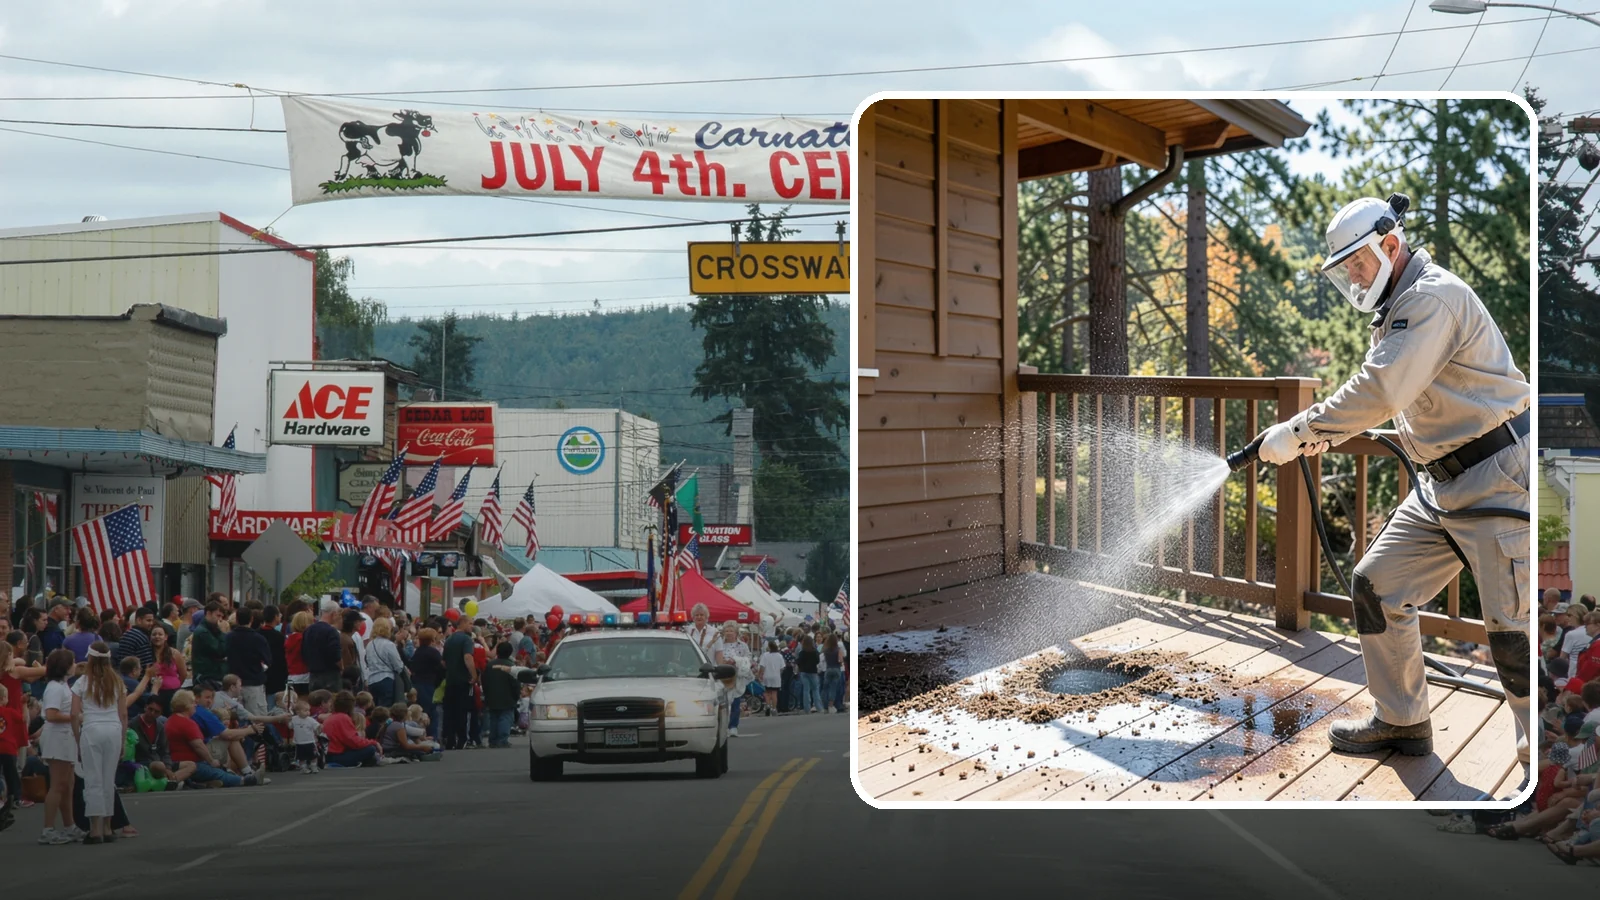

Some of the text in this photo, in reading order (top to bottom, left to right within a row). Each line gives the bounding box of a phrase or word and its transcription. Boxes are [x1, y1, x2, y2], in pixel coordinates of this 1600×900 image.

[695, 121, 850, 150] Carnat
[481, 140, 605, 193] JULY
[632, 150, 746, 198] 4th.
[697, 254, 850, 280] CROSSWA
[283, 380, 374, 420] ACE
[406, 409, 452, 422] CEDAR
[283, 421, 371, 437] Hardware
[83, 485, 155, 495] St. Vincent de Paul
[80, 503, 153, 522] THT
[688, 526, 741, 535] CRNATION
[699, 535, 730, 543] GLASS
